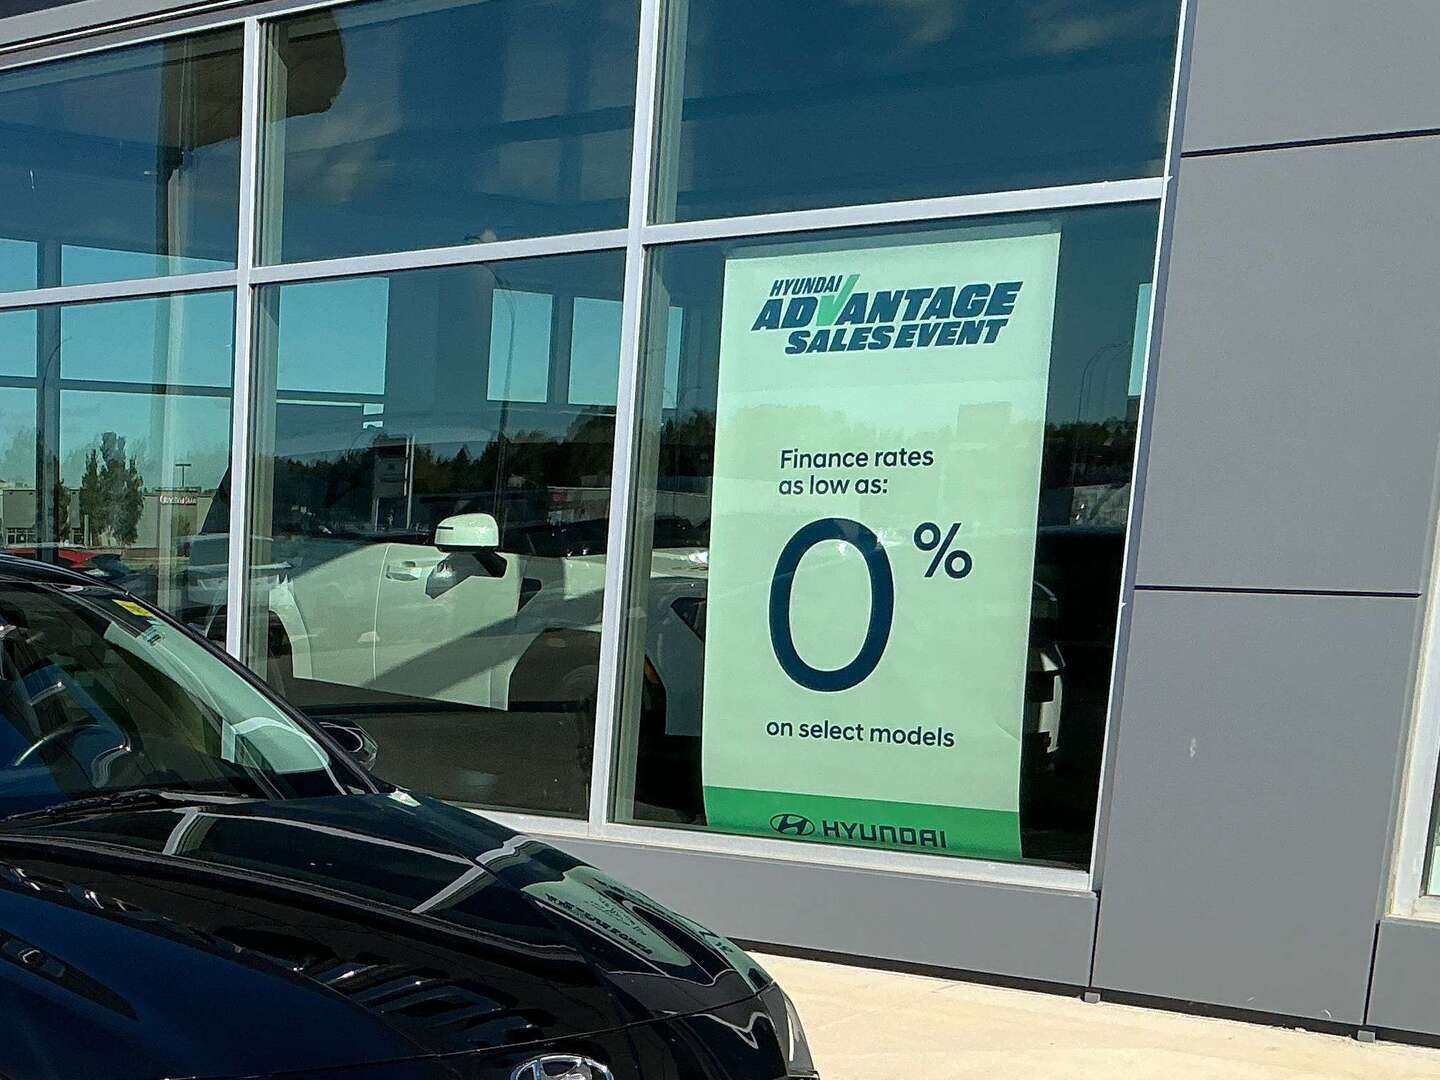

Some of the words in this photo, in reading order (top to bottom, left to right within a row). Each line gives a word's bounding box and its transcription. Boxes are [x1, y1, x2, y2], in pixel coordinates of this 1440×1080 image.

[769, 274, 844, 297] HYUNDAI
[750, 276, 1024, 331] ADVANTAGE
[784, 324, 894, 355] SALES
[892, 318, 1009, 348] EVENT
[780, 449, 869, 469] Finance
[874, 448, 935, 467] rates
[778, 479, 803, 495] as
[809, 475, 850, 495] low
[854, 477, 889, 494] as:
[766, 721, 793, 737] on
[798, 720, 865, 742] select
[869, 726, 955, 748] models
[822, 819, 947, 849] HYUNDAI
